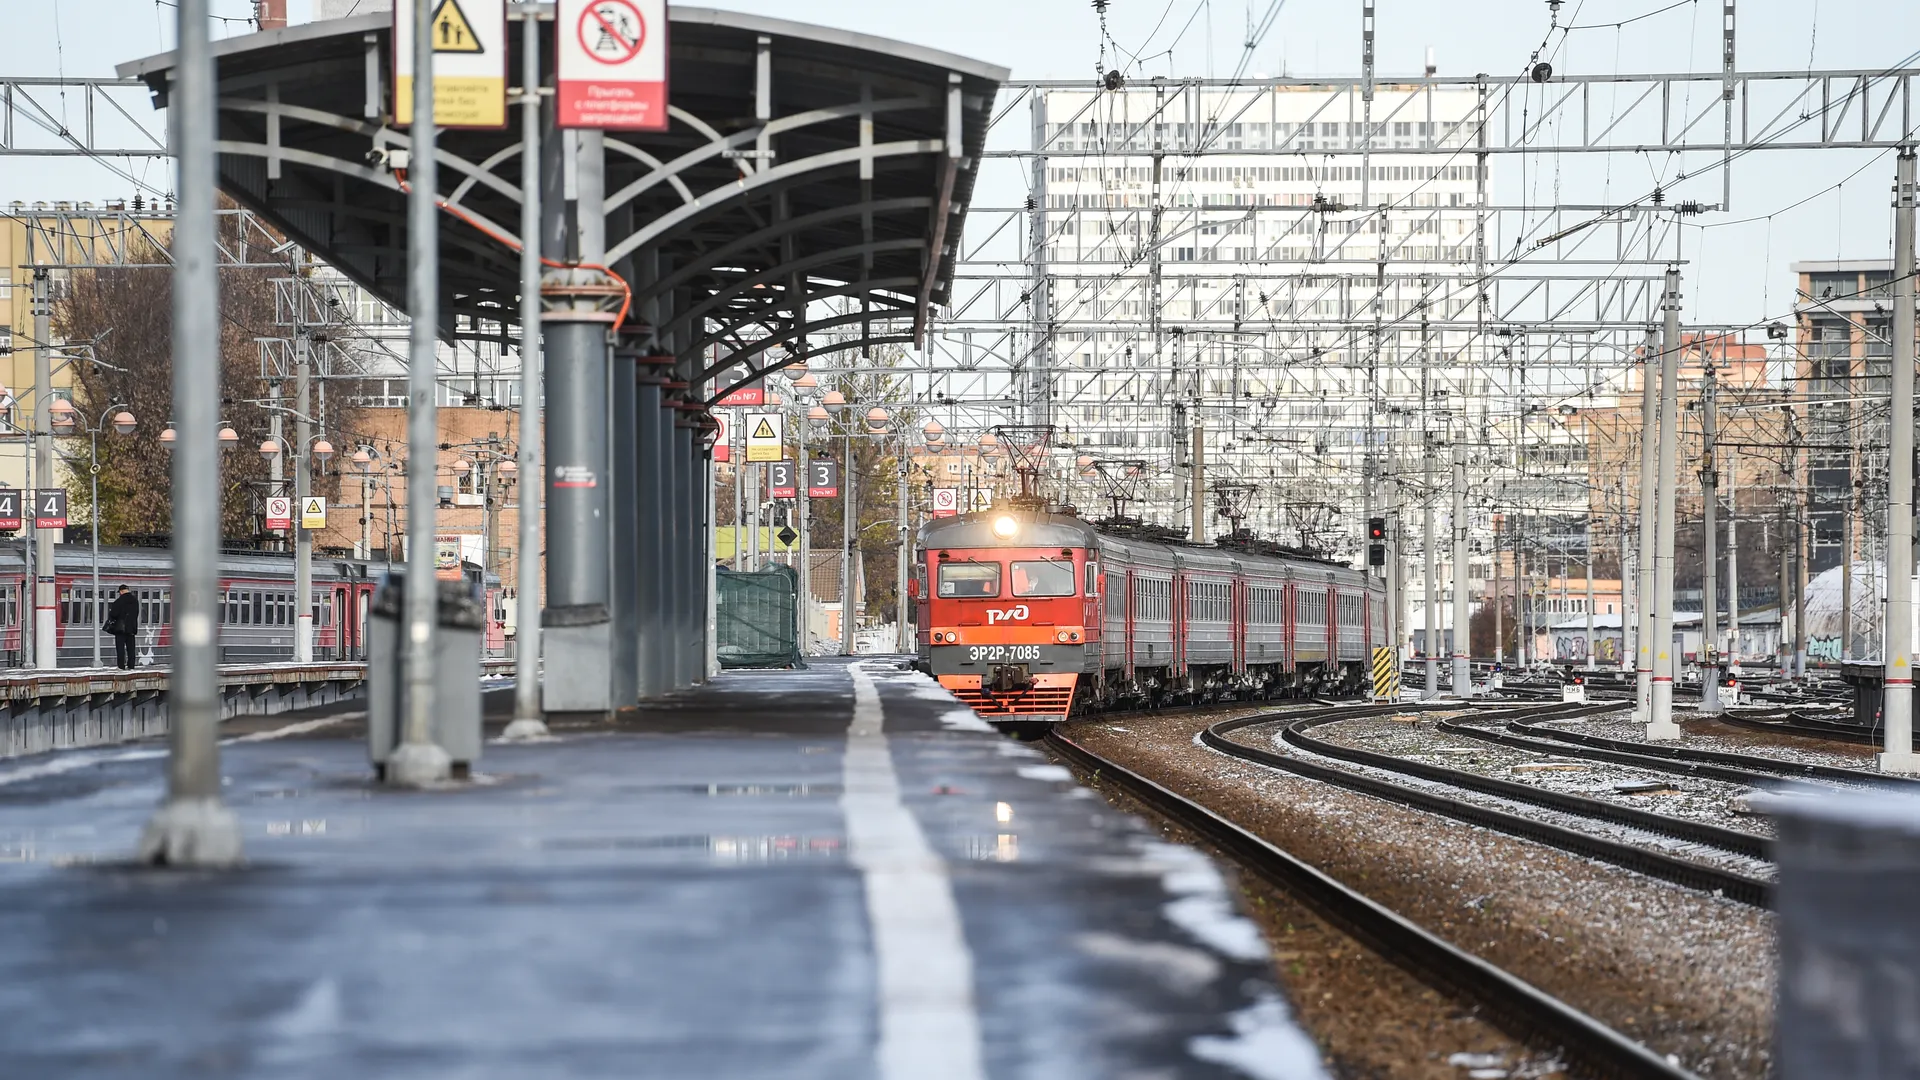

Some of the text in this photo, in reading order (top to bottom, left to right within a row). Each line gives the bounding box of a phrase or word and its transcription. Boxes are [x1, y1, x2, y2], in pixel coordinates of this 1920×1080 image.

[742, 392, 757, 400] №7
[774, 466, 787, 486] 3
[816, 466, 829, 486] 3
[0, 497, 14, 516] 4
[43, 497, 59, 516] 4
[969, 645, 1041, 661] ЭР2Р-7085
